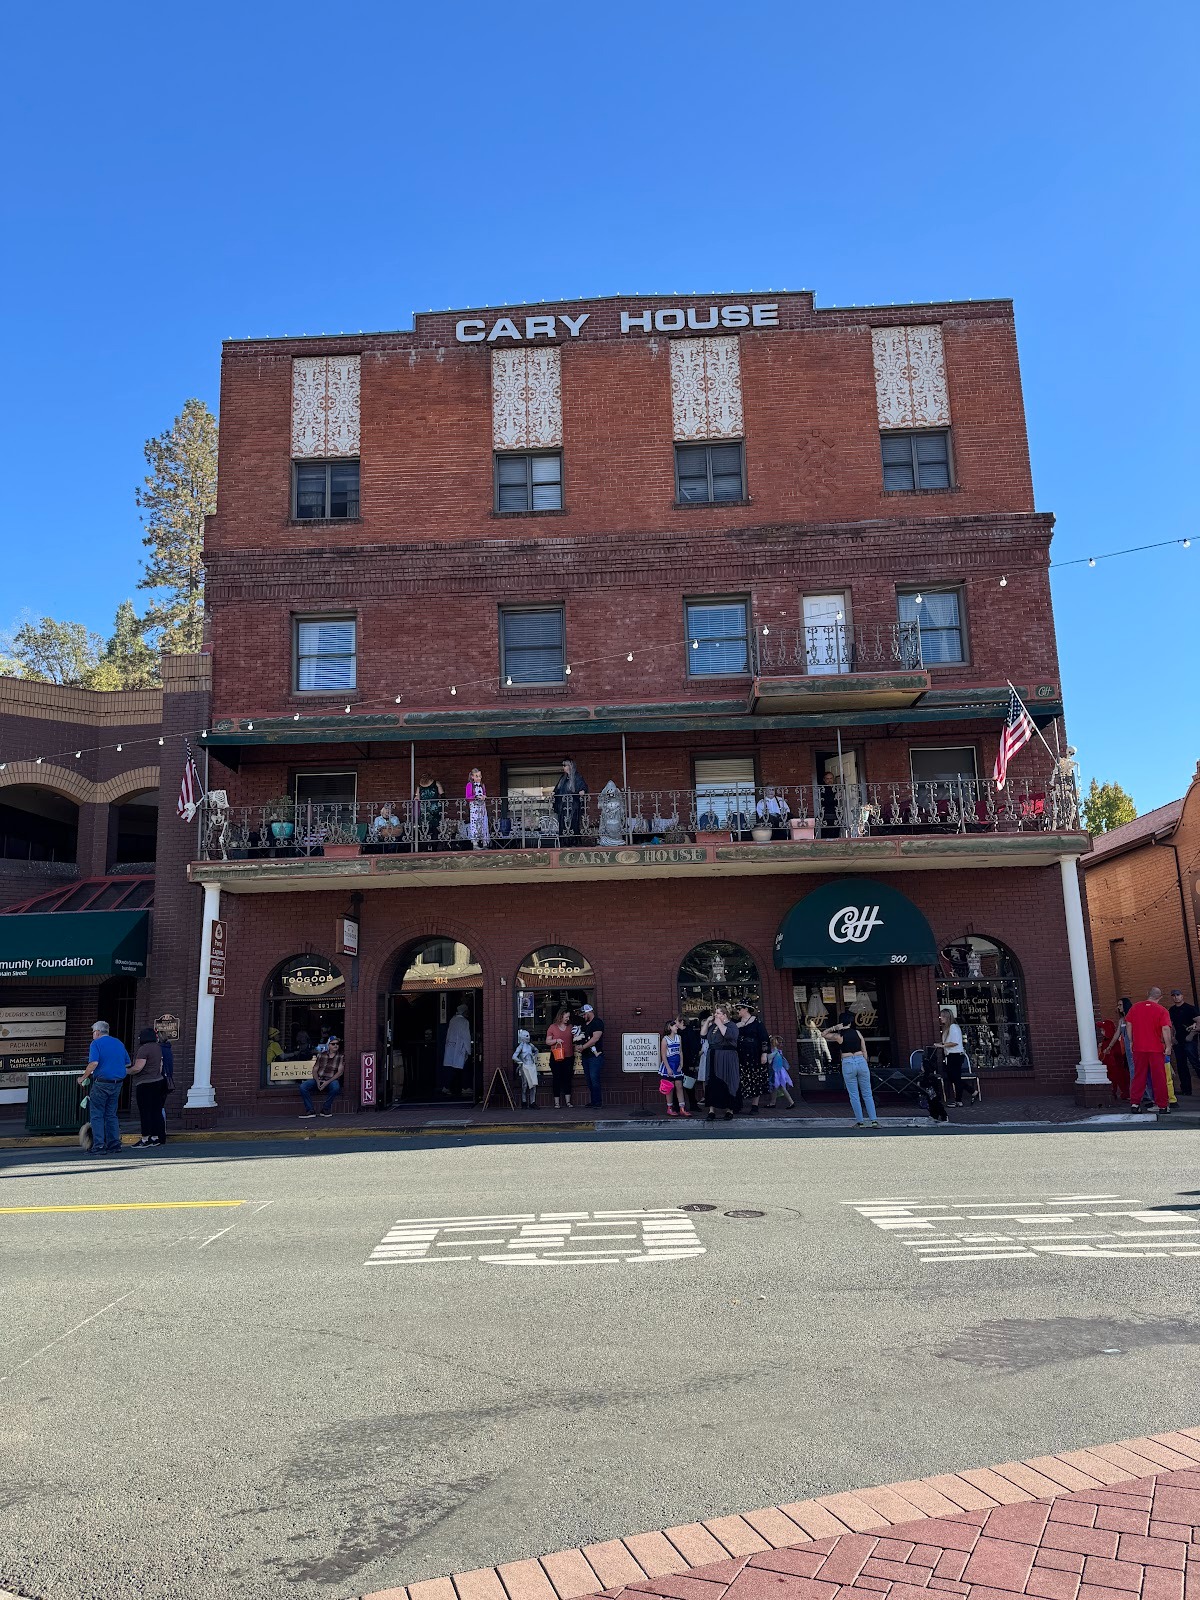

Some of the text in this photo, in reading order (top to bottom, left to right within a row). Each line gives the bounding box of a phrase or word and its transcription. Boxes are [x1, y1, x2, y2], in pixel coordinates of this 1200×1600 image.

[456, 303, 780, 342] CARY HOUSE
[563, 851, 612, 865] CARY
[643, 848, 703, 862] HOUSE
[36, 957, 94, 968] Foundation
[890, 955, 908, 963] 300
[529, 966, 581, 975] TOOGOOD
[282, 975, 334, 984] TOOGOOD
[433, 976, 448, 985] 304
[941, 996, 1014, 1006] Historic Cary House
[685, 1003, 713, 1011] Historic
[968, 1005, 989, 1013] Hotel
[10, 1041, 48, 1049] PACHAMAMA
[364, 1056, 373, 1101] OPEN
